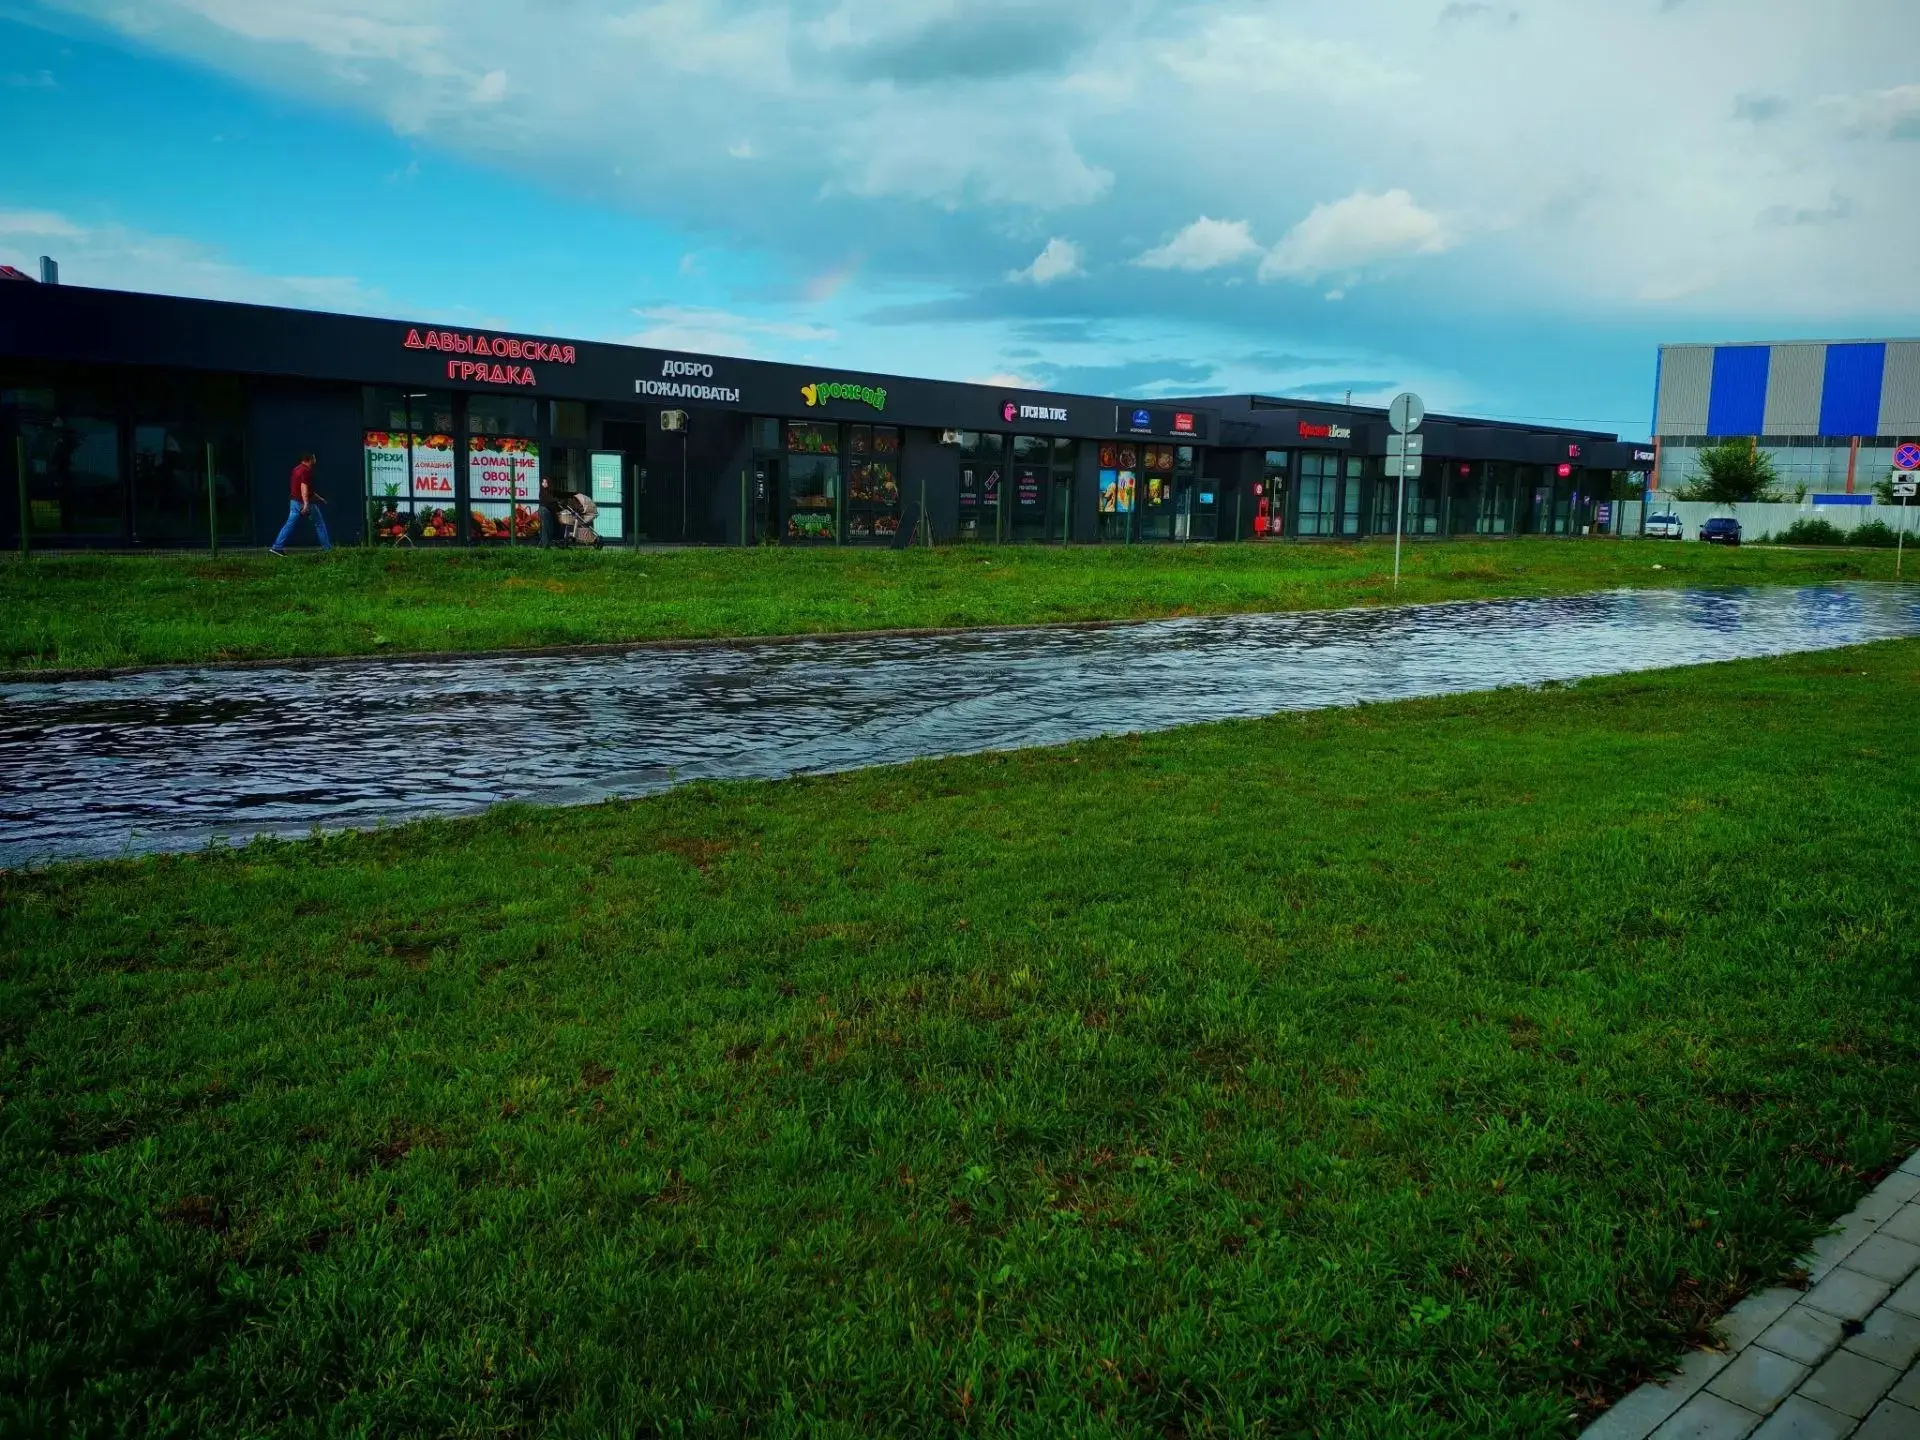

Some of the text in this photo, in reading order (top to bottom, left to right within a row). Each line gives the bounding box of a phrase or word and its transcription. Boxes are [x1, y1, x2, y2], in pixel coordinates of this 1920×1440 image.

[404, 328, 576, 364] ДАВЫДОВСКАЯ
[447, 360, 537, 386] ГРЯДКА
[661, 359, 714, 378] ДОБРО
[634, 378, 740, 403] ПОЖАЛОВАТЬ!
[370, 452, 404, 463] ОРЕХИ
[415, 473, 452, 491] МЁД
